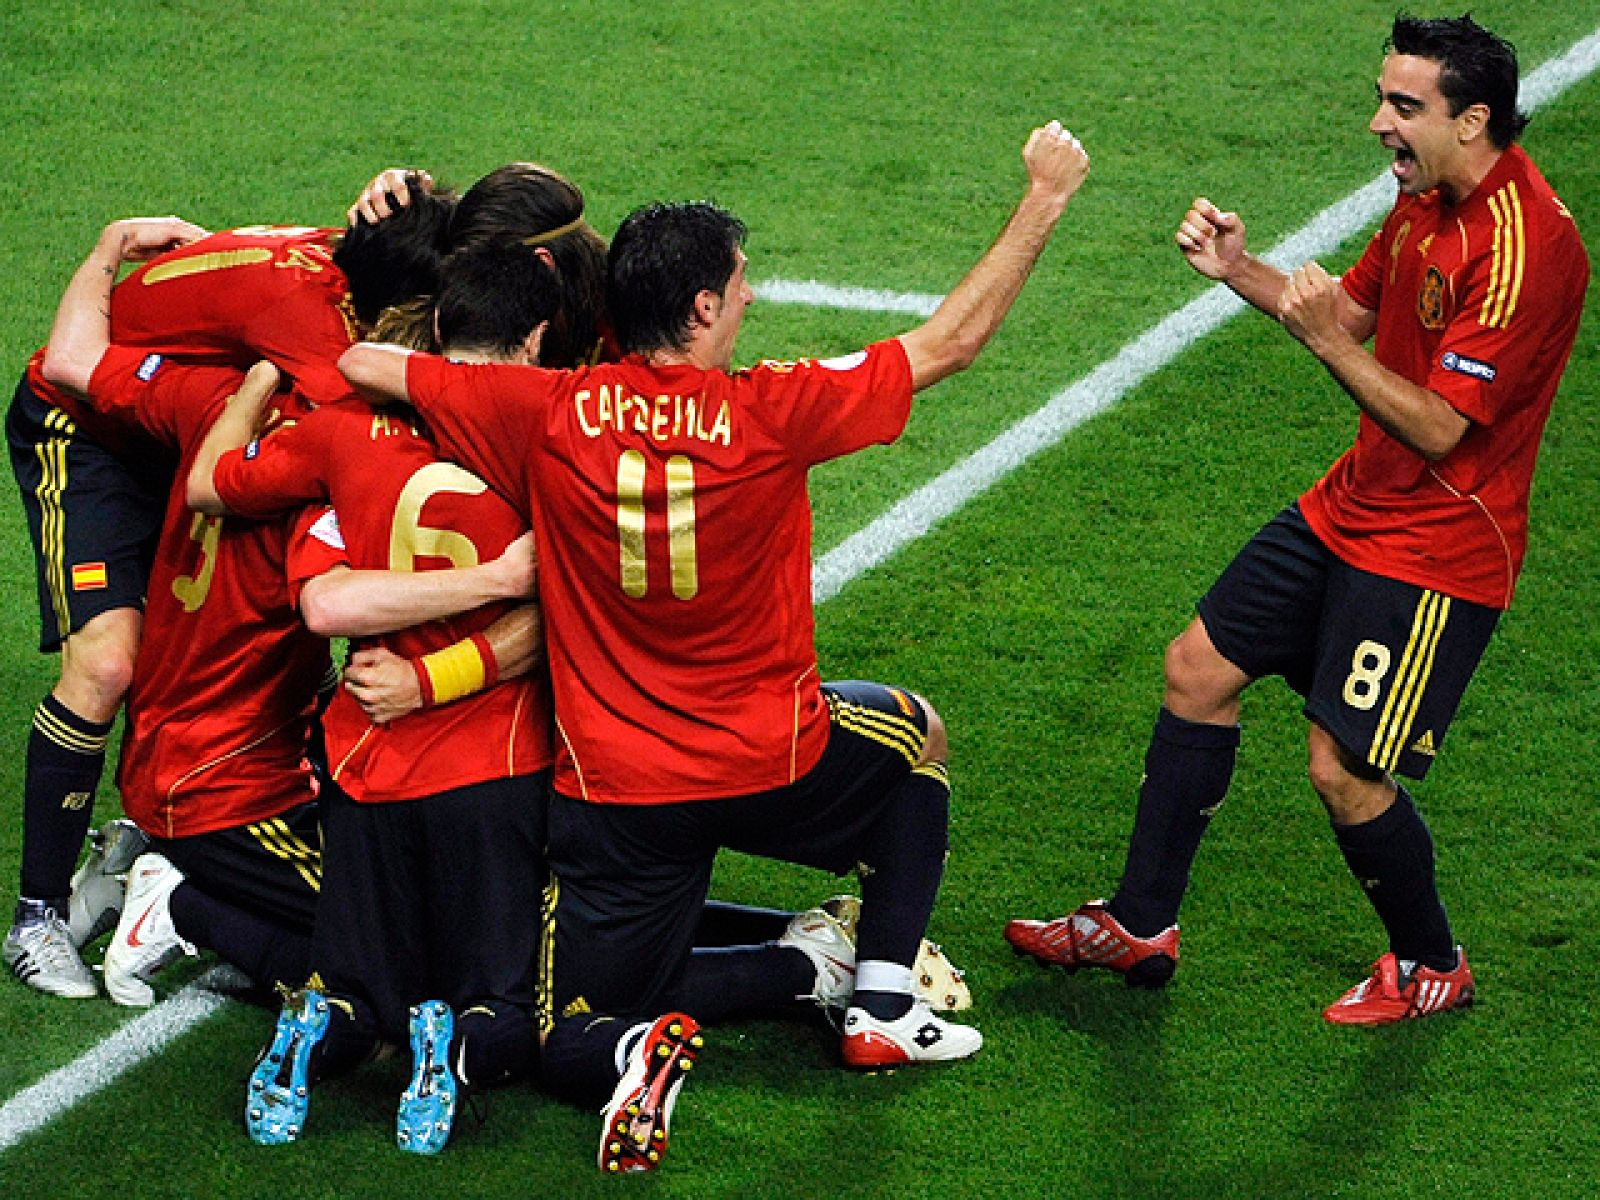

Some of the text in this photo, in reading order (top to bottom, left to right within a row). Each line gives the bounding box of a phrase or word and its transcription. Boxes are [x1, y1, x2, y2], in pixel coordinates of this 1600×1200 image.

[390, 462, 488, 571] 6
[616, 450, 698, 600] 11
[1342, 640, 1391, 711] 8
